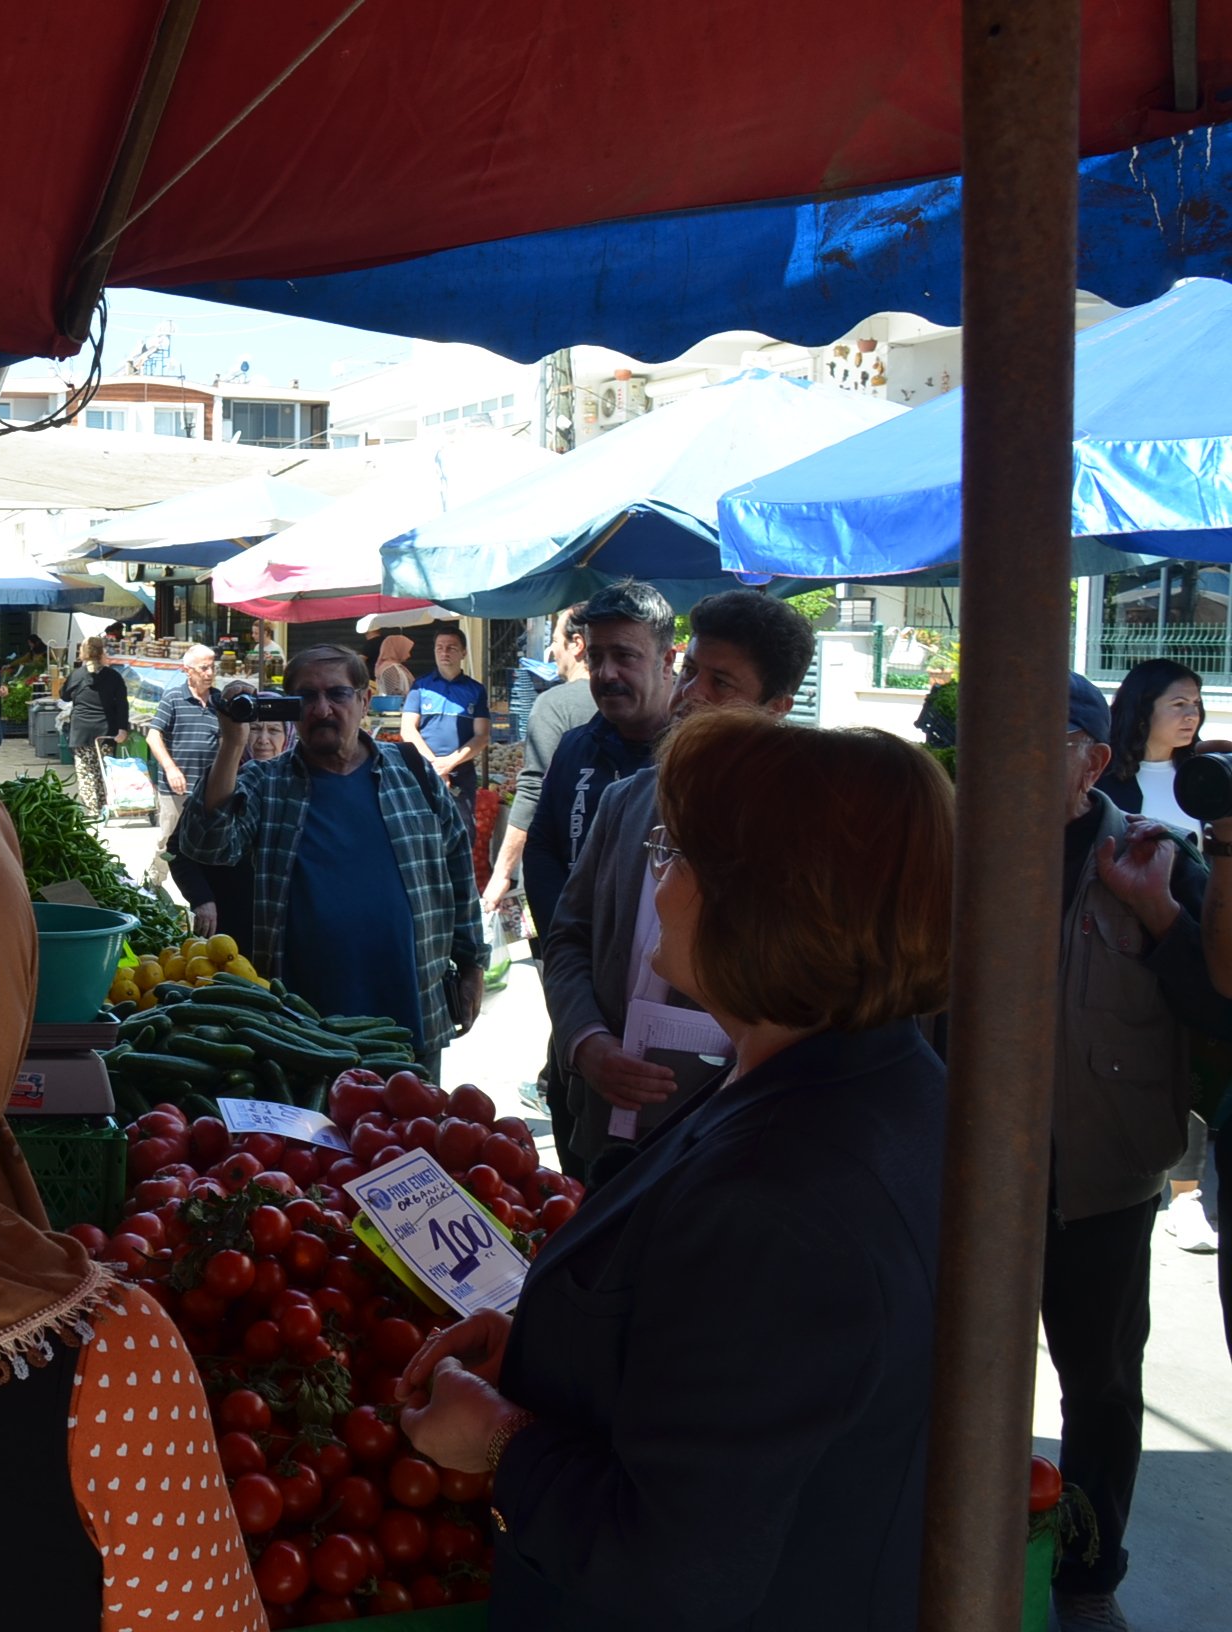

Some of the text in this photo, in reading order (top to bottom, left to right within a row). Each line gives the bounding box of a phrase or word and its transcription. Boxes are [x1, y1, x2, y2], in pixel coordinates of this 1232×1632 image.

[568, 768, 595, 869] ZABI
[387, 1165, 440, 1200] FİYAT ETİKETİ
[428, 1213, 493, 1283] 100
